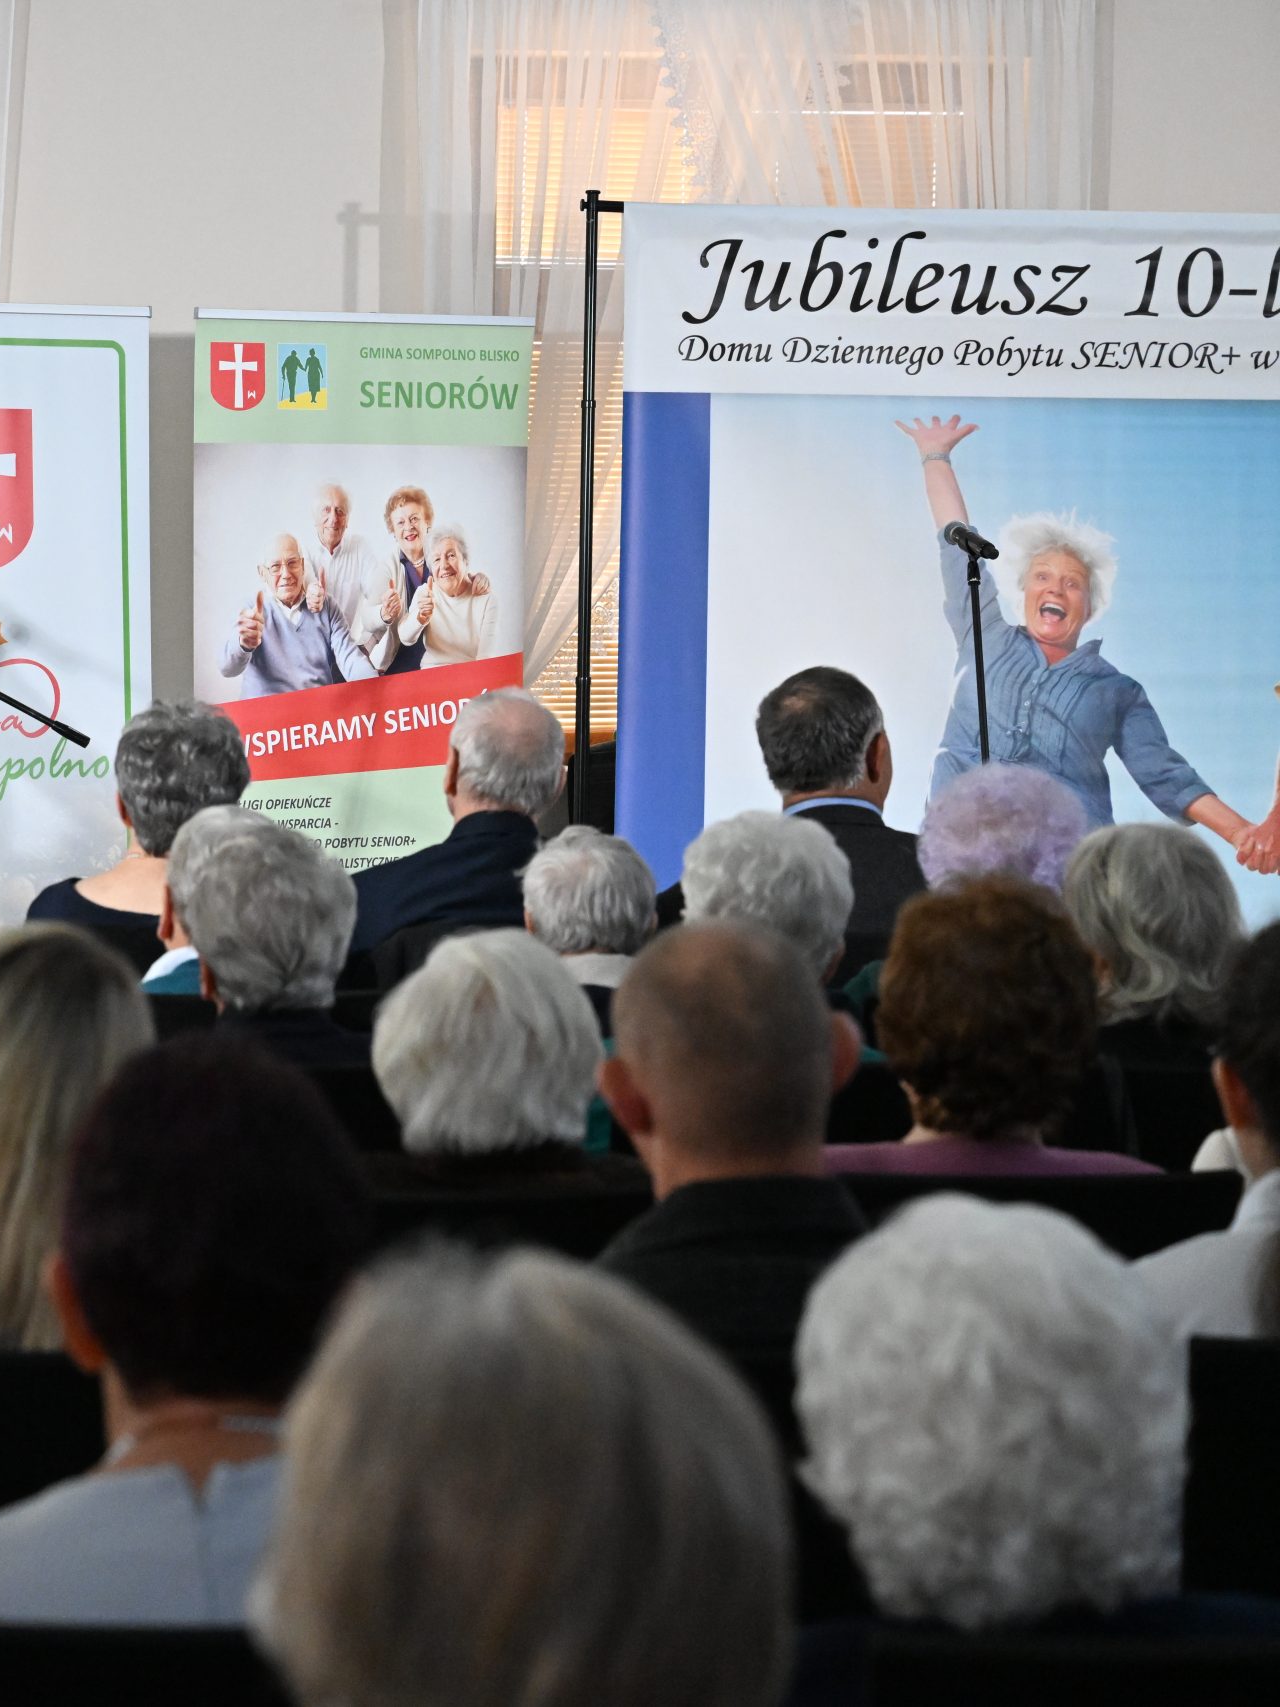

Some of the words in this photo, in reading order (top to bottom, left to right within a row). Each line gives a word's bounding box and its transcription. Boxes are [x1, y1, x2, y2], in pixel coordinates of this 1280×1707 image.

[682, 229, 1091, 324] Jubileusz
[359, 347, 403, 360] GMINA
[406, 348, 476, 361] SOMPOLNO
[479, 350, 520, 362] BLISKO
[678, 334, 772, 362] Domu
[782, 336, 944, 375] Dziennego
[953, 336, 1063, 376] Pobytu
[1071, 341, 1241, 375] SENIOR+
[1251, 350, 1280, 370] w
[359, 375, 519, 410] SENIORÓW
[265, 795, 332, 810] OPIEKUŃCZE
[278, 817, 331, 830] WSPARCIA
[325, 837, 369, 849] POBYTU
[371, 835, 417, 847] SENIOR+
